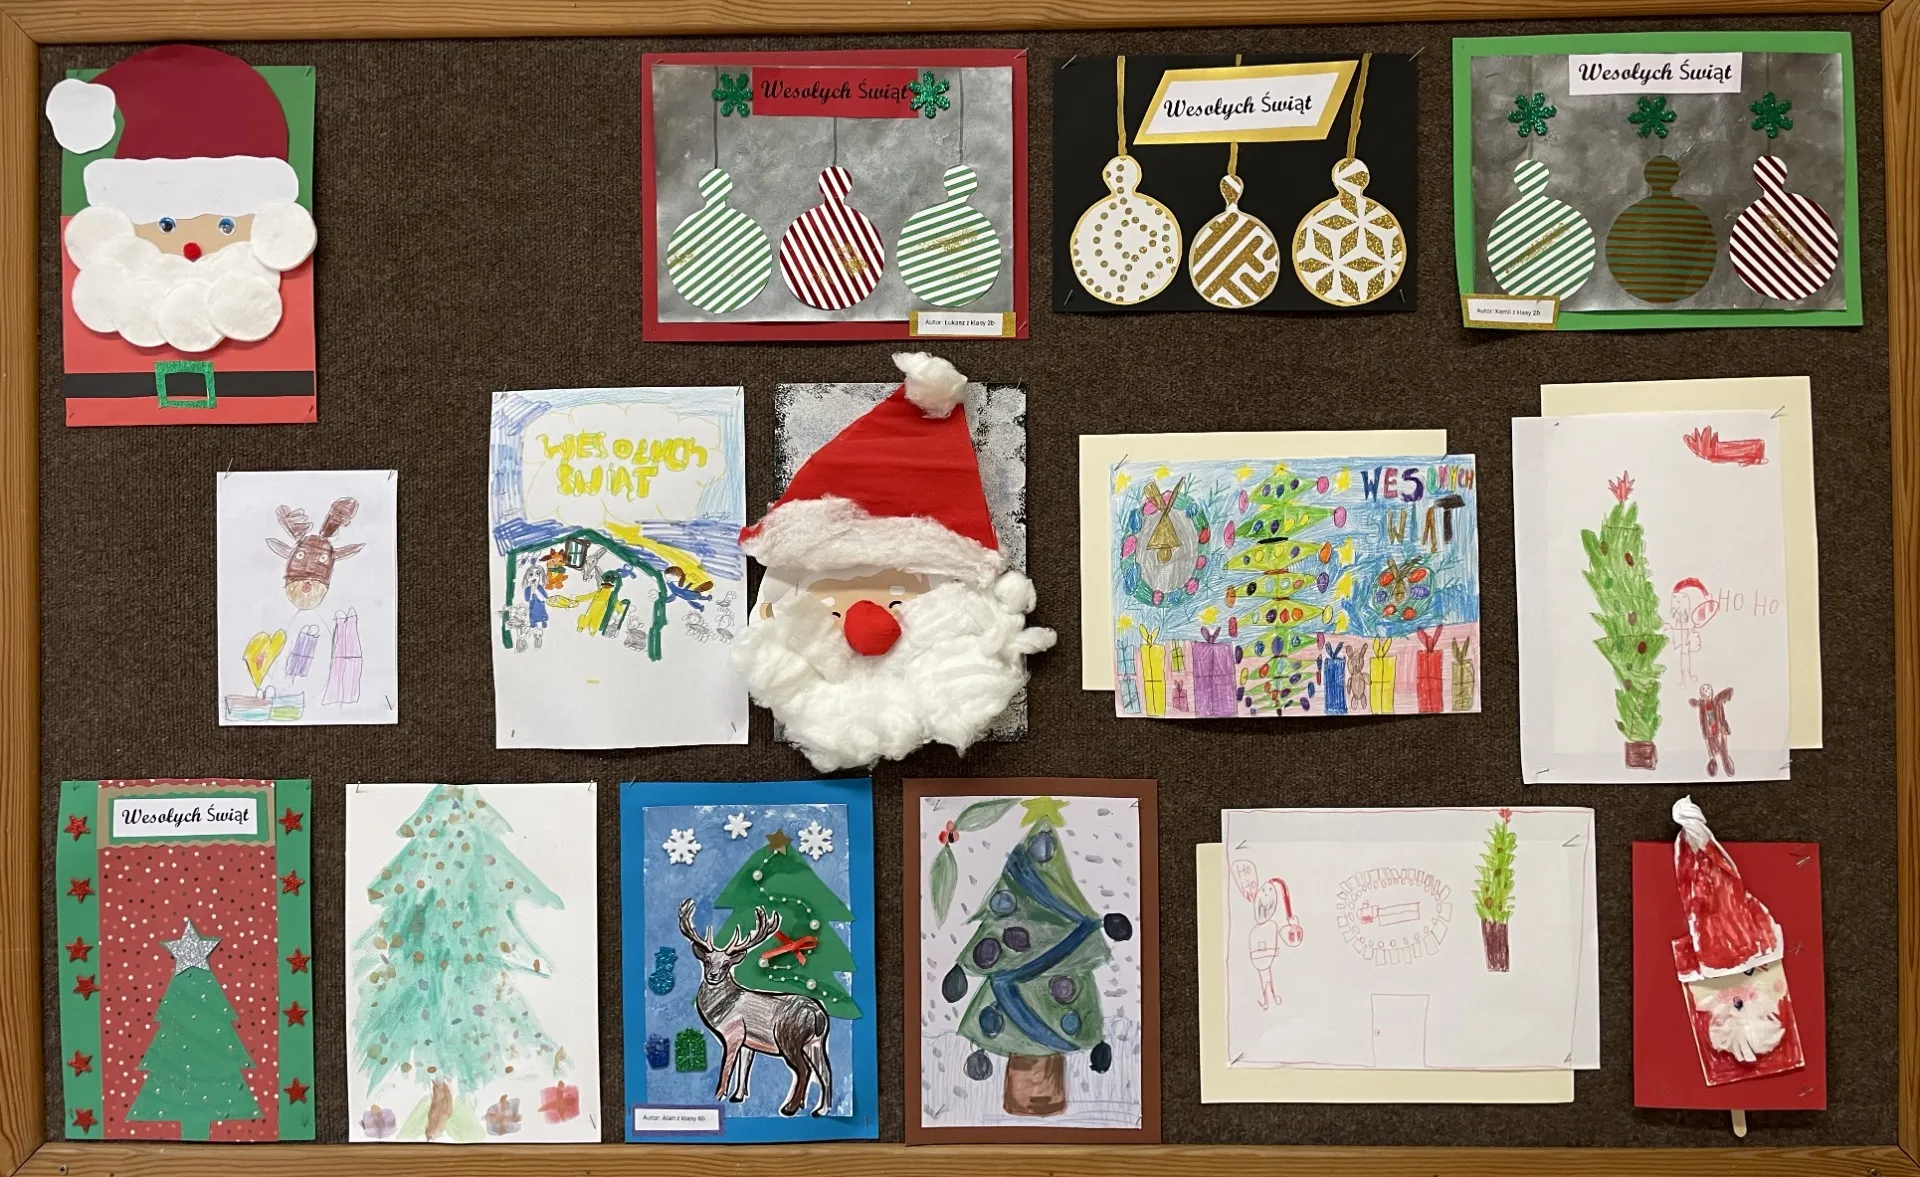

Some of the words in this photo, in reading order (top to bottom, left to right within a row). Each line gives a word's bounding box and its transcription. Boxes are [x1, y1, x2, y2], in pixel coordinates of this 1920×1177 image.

[1579, 62, 1673, 86] Wesołych
[1679, 59, 1732, 83] Świąt
[760, 80, 852, 104] Wesołych
[858, 78, 908, 103] Świąt
[1163, 96, 1255, 121] Wesołych
[1261, 91, 1313, 115] Świąt
[121, 806, 202, 828] Wesołych
[207, 804, 249, 825] Świąt
